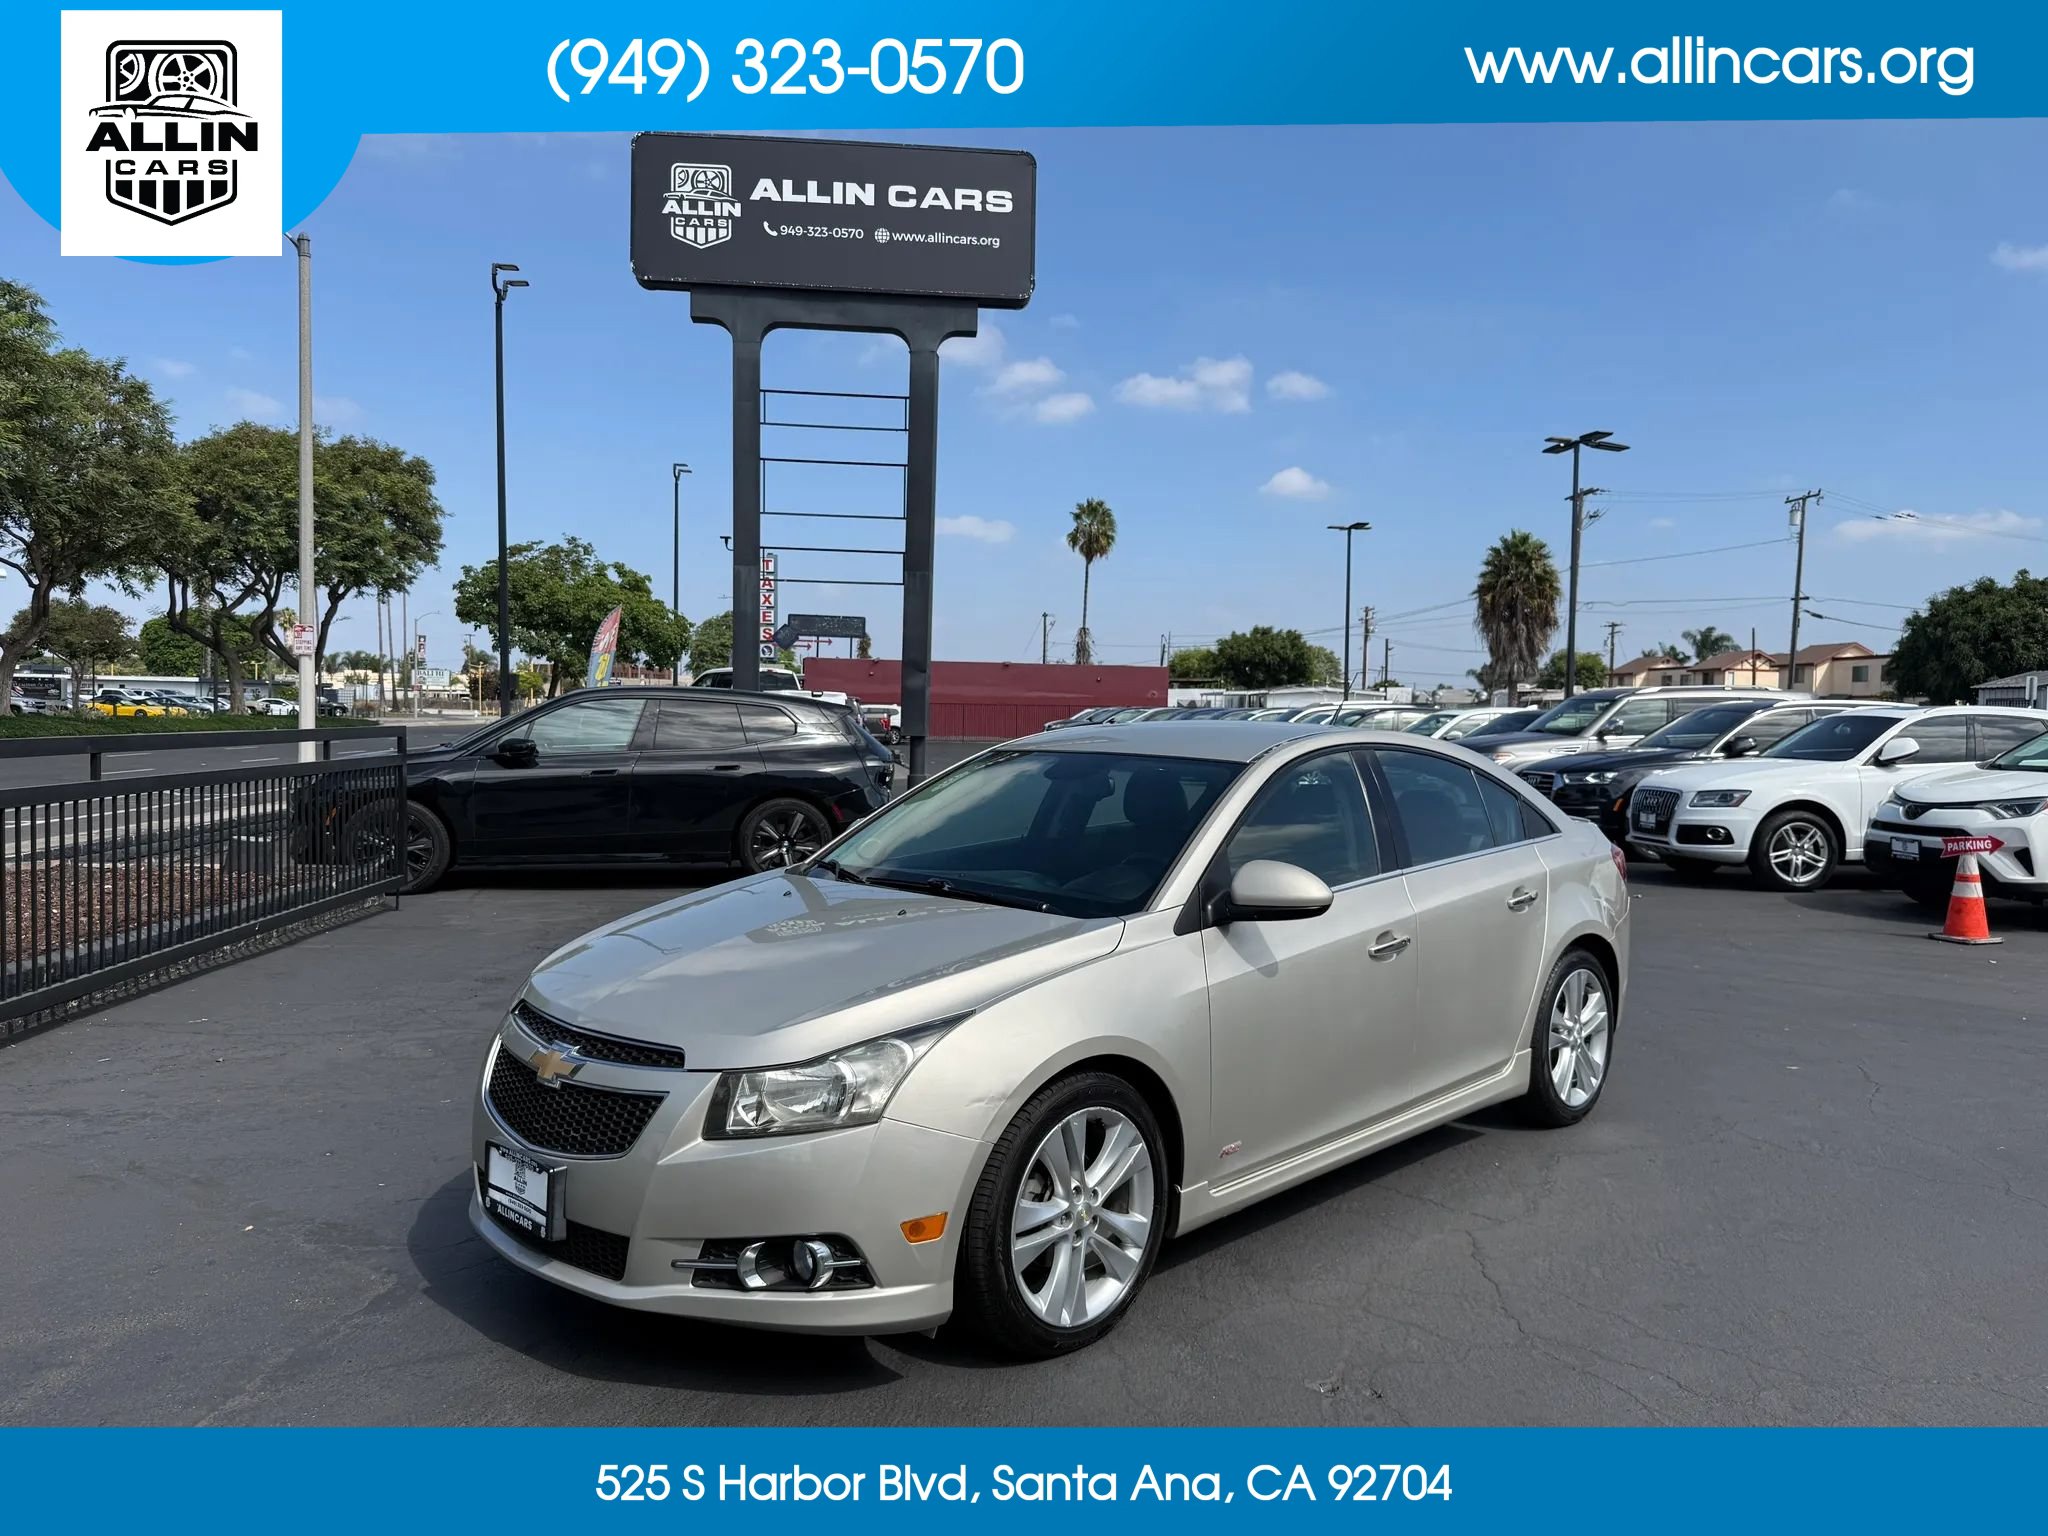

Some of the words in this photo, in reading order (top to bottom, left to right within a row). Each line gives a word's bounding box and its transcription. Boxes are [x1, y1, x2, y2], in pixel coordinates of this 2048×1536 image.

[750, 178, 875, 206] ALLIN
[888, 185, 1013, 213] CARS
[662, 200, 741, 217] ALLIN
[675, 217, 728, 227] CARS
[780, 225, 864, 239] 949-323-0570
[892, 232, 1000, 249] www.allincars.org
[761, 559, 773, 641] TAXES
[1947, 840, 1992, 852] PARKING
